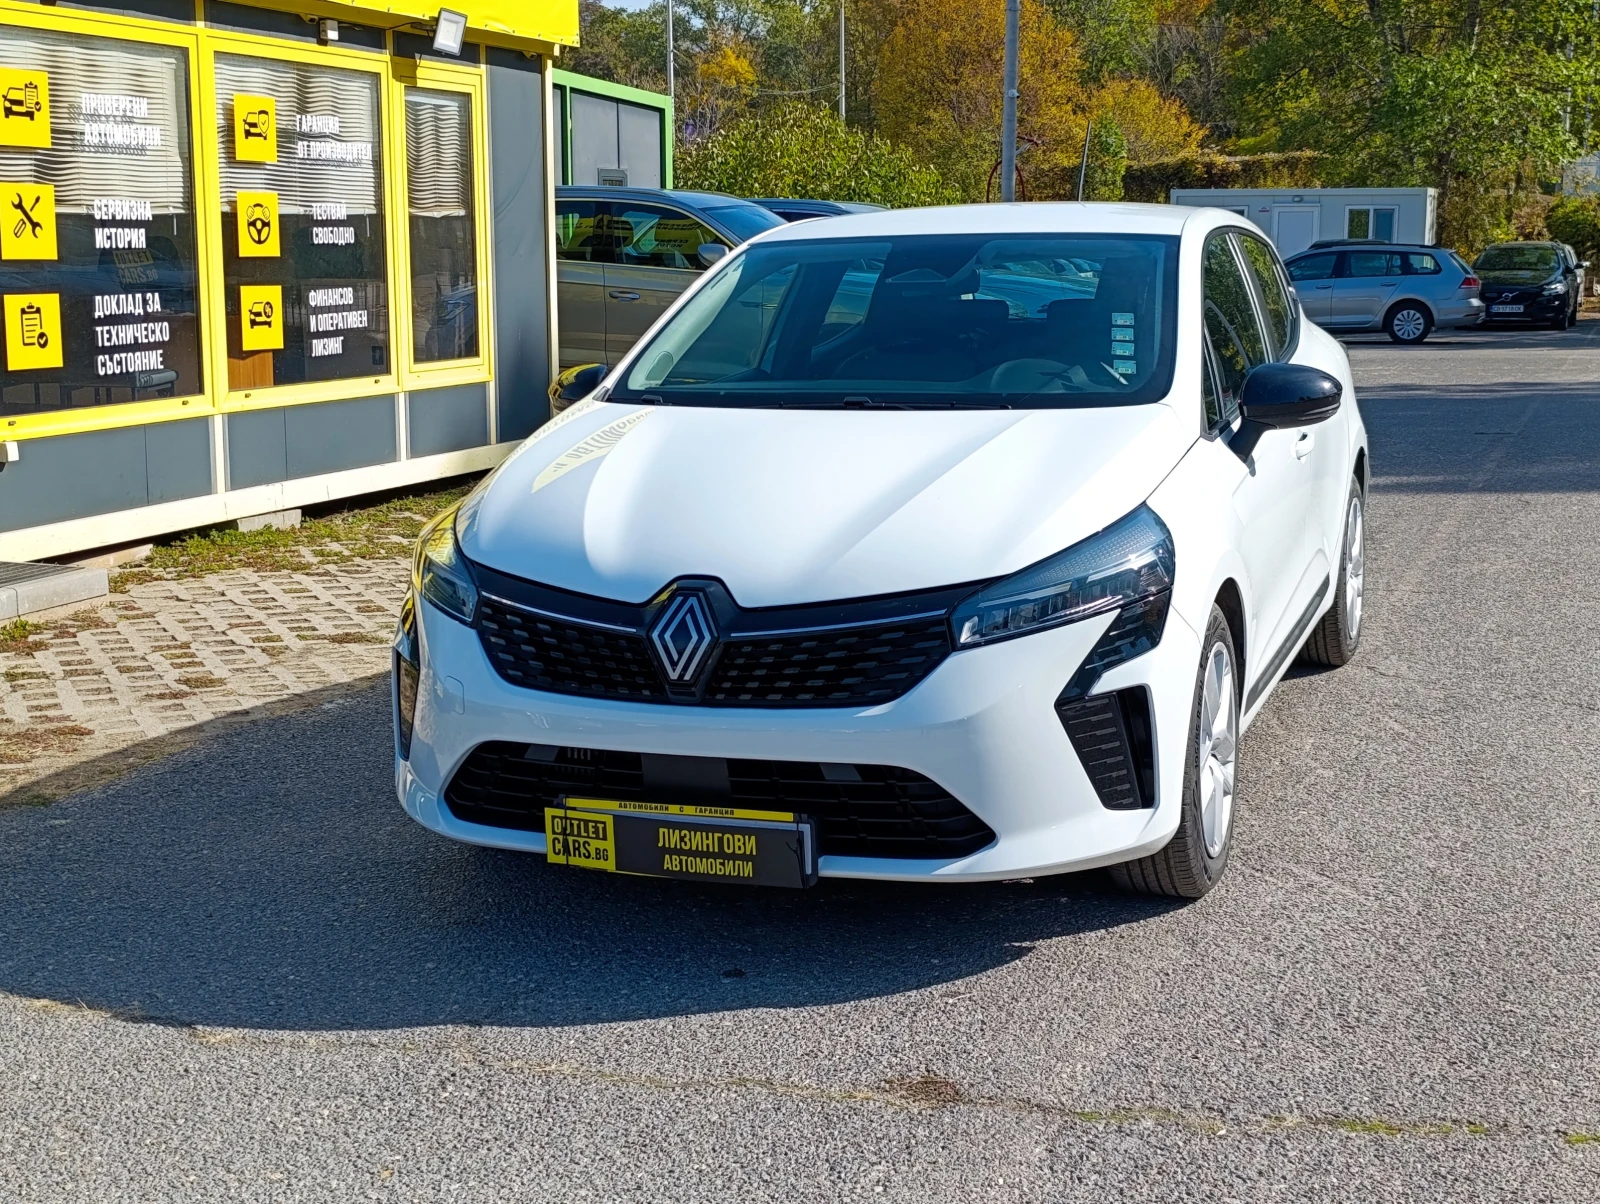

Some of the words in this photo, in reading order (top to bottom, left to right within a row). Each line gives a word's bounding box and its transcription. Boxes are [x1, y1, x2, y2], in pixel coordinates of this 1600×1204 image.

[81, 93, 148, 117] ПРОВЕРЕНИ
[84, 122, 161, 146] АВТОМОБИЛИ
[296, 114, 340, 134] ГАРАНЦИЯ
[297, 141, 309, 159] ОТ
[310, 142, 373, 162] ПРОИЗВОДИТЕЛ
[93, 199, 152, 221] СЕРВИЗНА
[311, 201, 347, 220] ТЕСТВАЙ
[94, 228, 147, 249] ИСТОРИЯ
[312, 226, 355, 246] СВОБОДНО
[94, 293, 144, 319] ДОКЛАД
[146, 292, 161, 313] ЗА
[308, 287, 354, 308] ФИНАНСОВ
[310, 314, 317, 333] И
[317, 310, 368, 332] ОПЕРАТИВЕН
[95, 321, 170, 347] ТЕХНИЧЕСКО
[311, 336, 344, 357] ЛИЗИНГ
[97, 349, 164, 376] СЪСТОЯНИЕ
[618, 802, 669, 812] АВТОМОБИЛИ
[694, 806, 735, 816] ГАРАНЦИЯ
[553, 818, 605, 839] OUTLET
[551, 836, 609, 862] CARS.BG
[657, 827, 757, 856] ЛИЗИНГОВИ
[663, 854, 753, 878] АВТОМОБИЛИ
